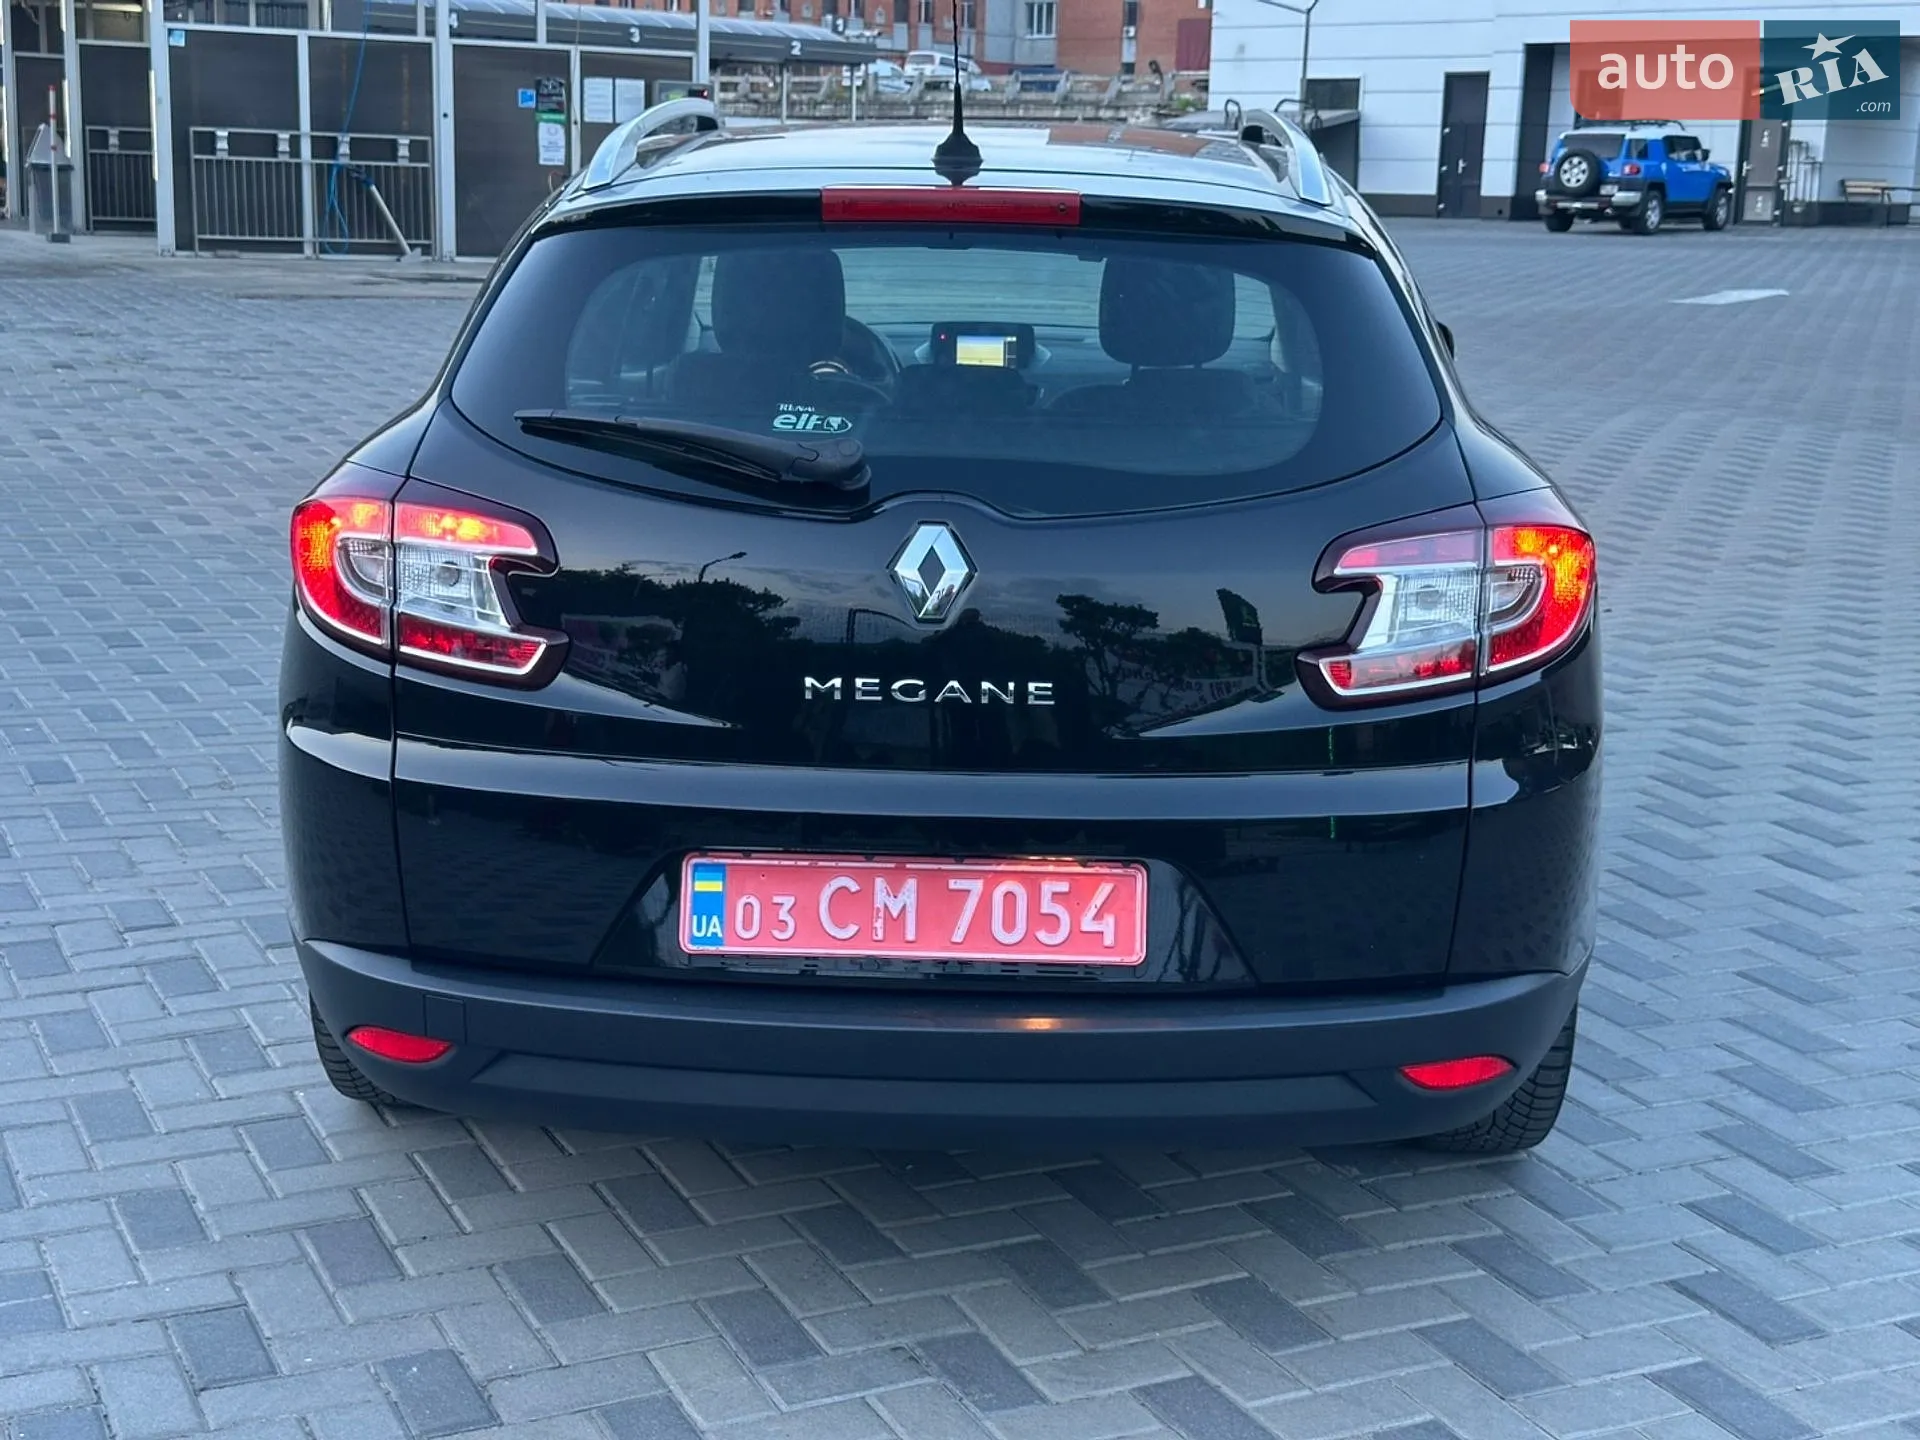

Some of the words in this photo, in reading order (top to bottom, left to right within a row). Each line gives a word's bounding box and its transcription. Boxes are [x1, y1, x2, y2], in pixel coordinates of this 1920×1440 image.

[630, 27, 640, 43] 3
[790, 40, 802, 56] 2
[773, 413, 823, 430] elf
[804, 676, 1055, 705] MEGANE
[734, 894, 796, 941] 03
[818, 875, 918, 943] CM
[947, 878, 1116, 948] 7054
[691, 914, 723, 938] UA
